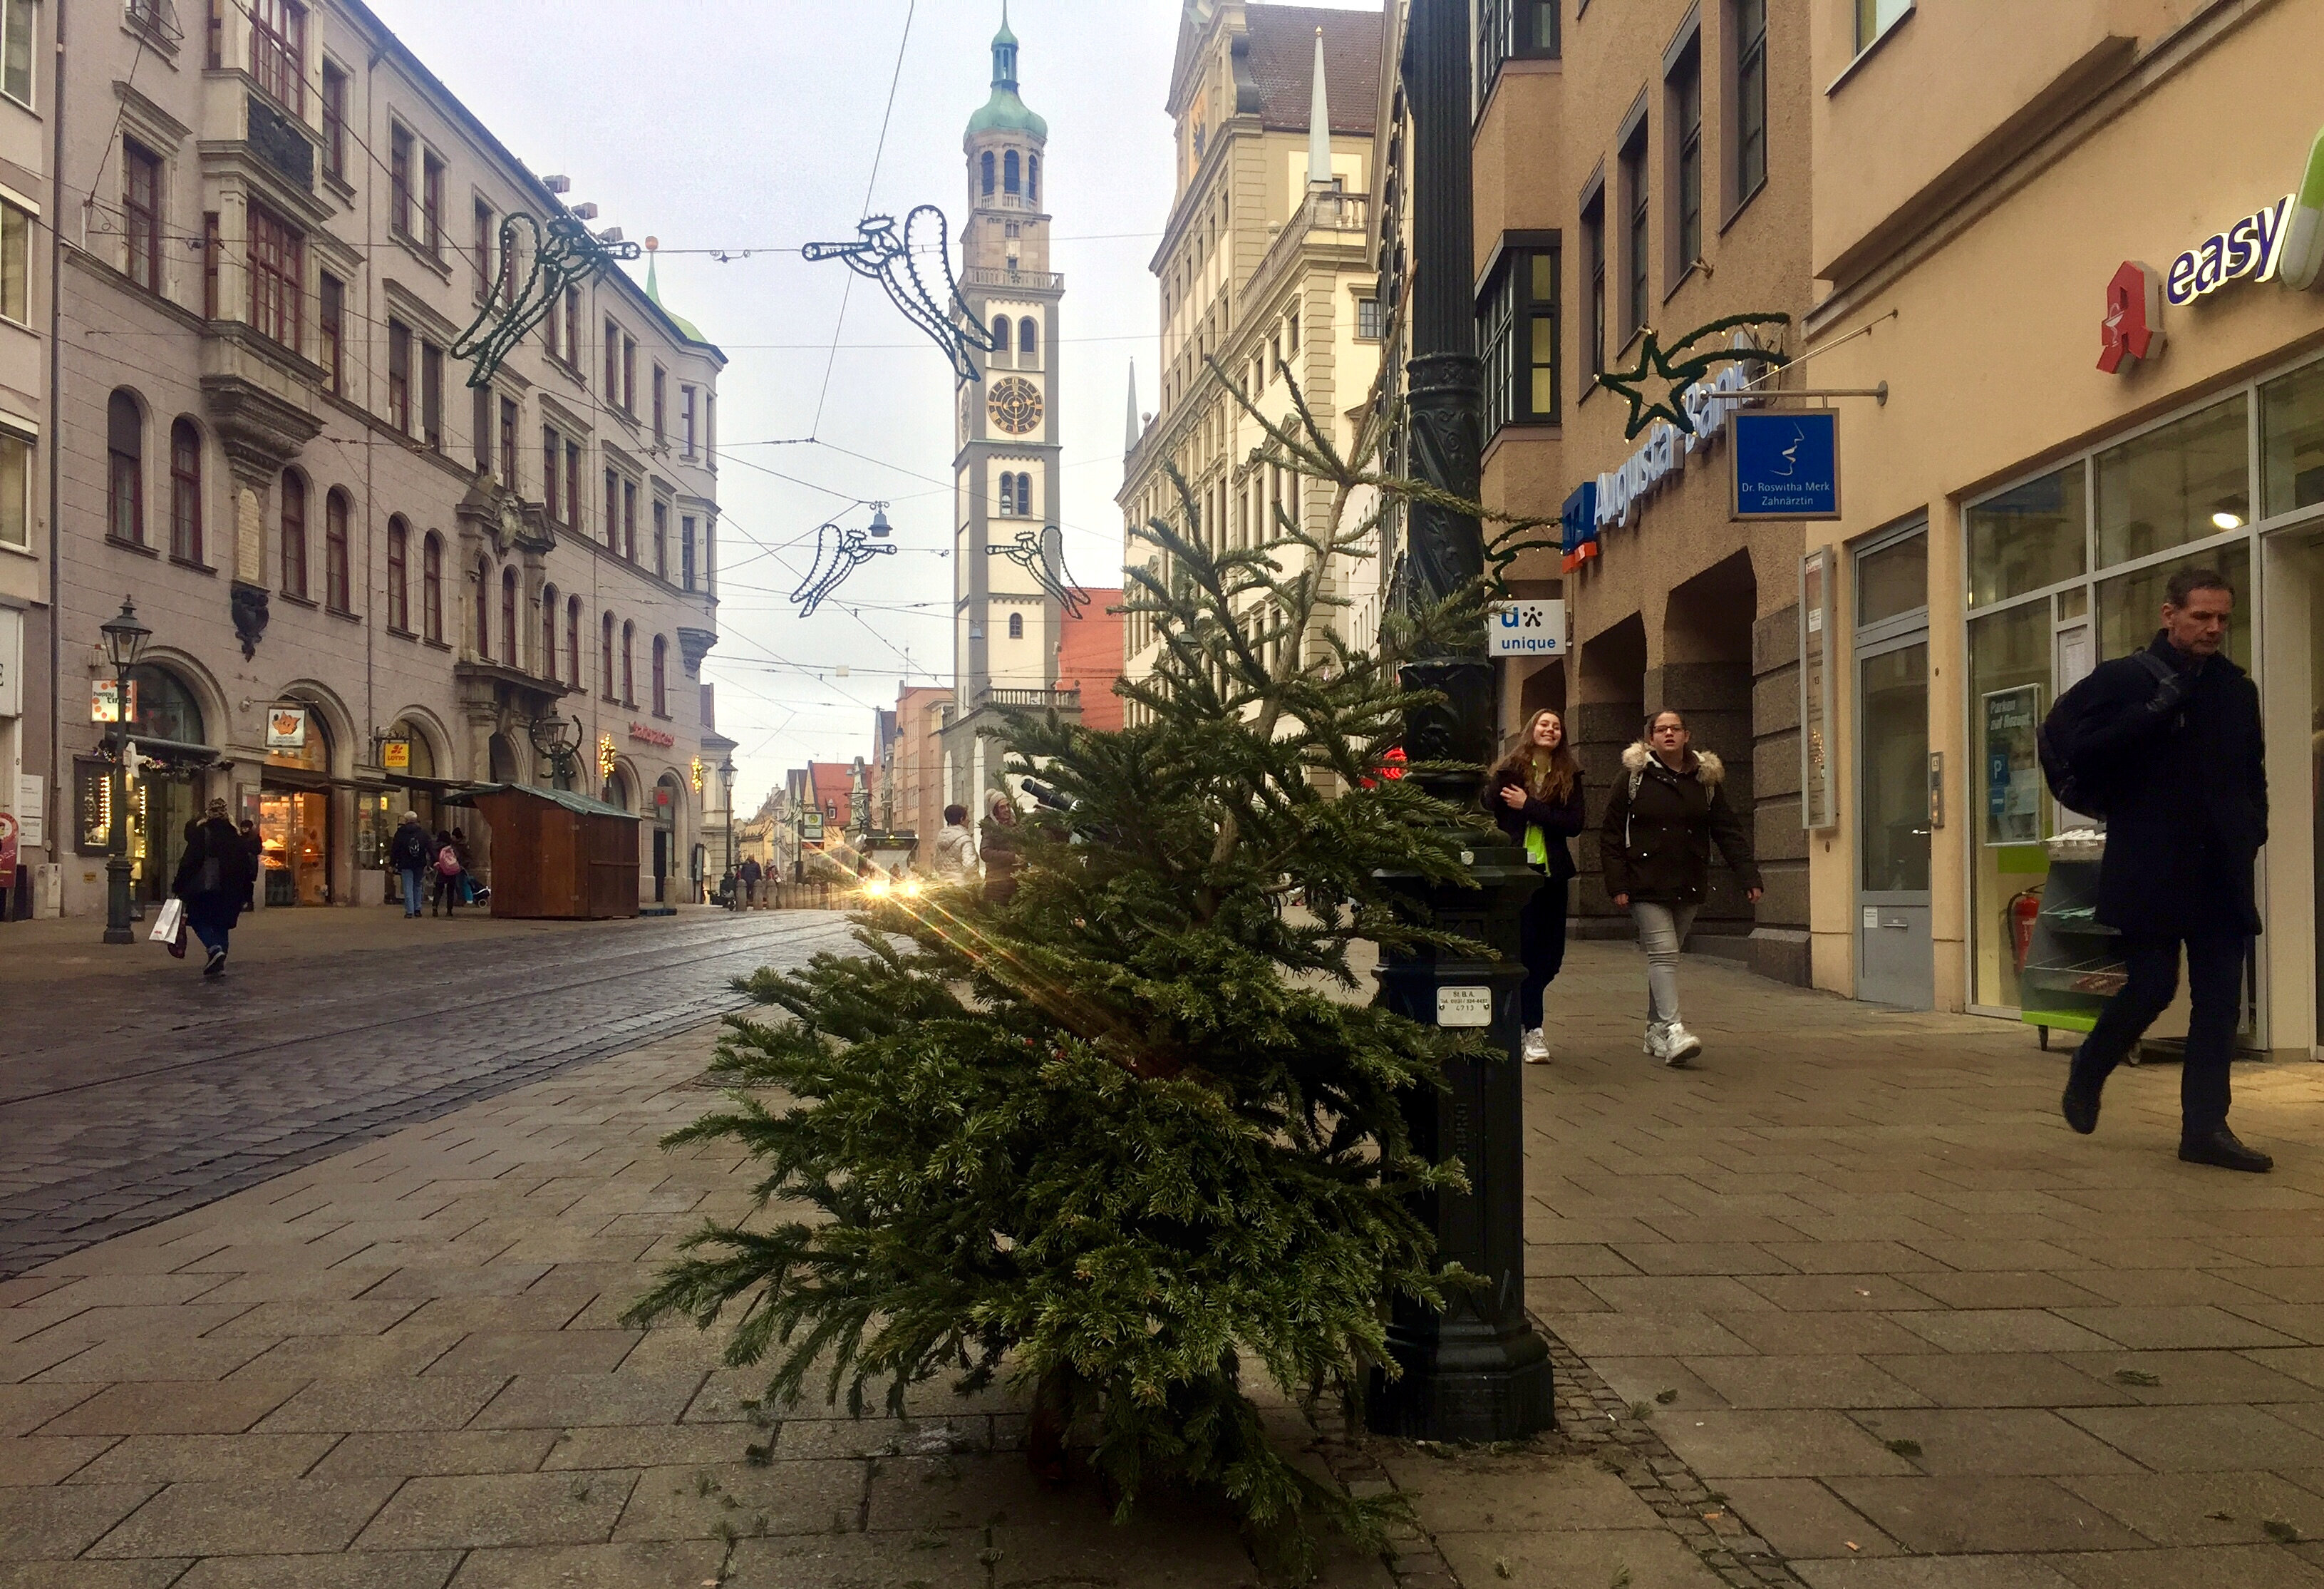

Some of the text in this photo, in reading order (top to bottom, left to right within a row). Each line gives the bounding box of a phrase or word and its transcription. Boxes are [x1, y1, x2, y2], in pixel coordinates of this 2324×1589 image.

[2167, 194, 2293, 305] easy
[1742, 481, 1830, 492] Dr. Roswitha Merk
[1762, 496, 1814, 505] Zahnärztin
[1502, 636, 1556, 652] unique
